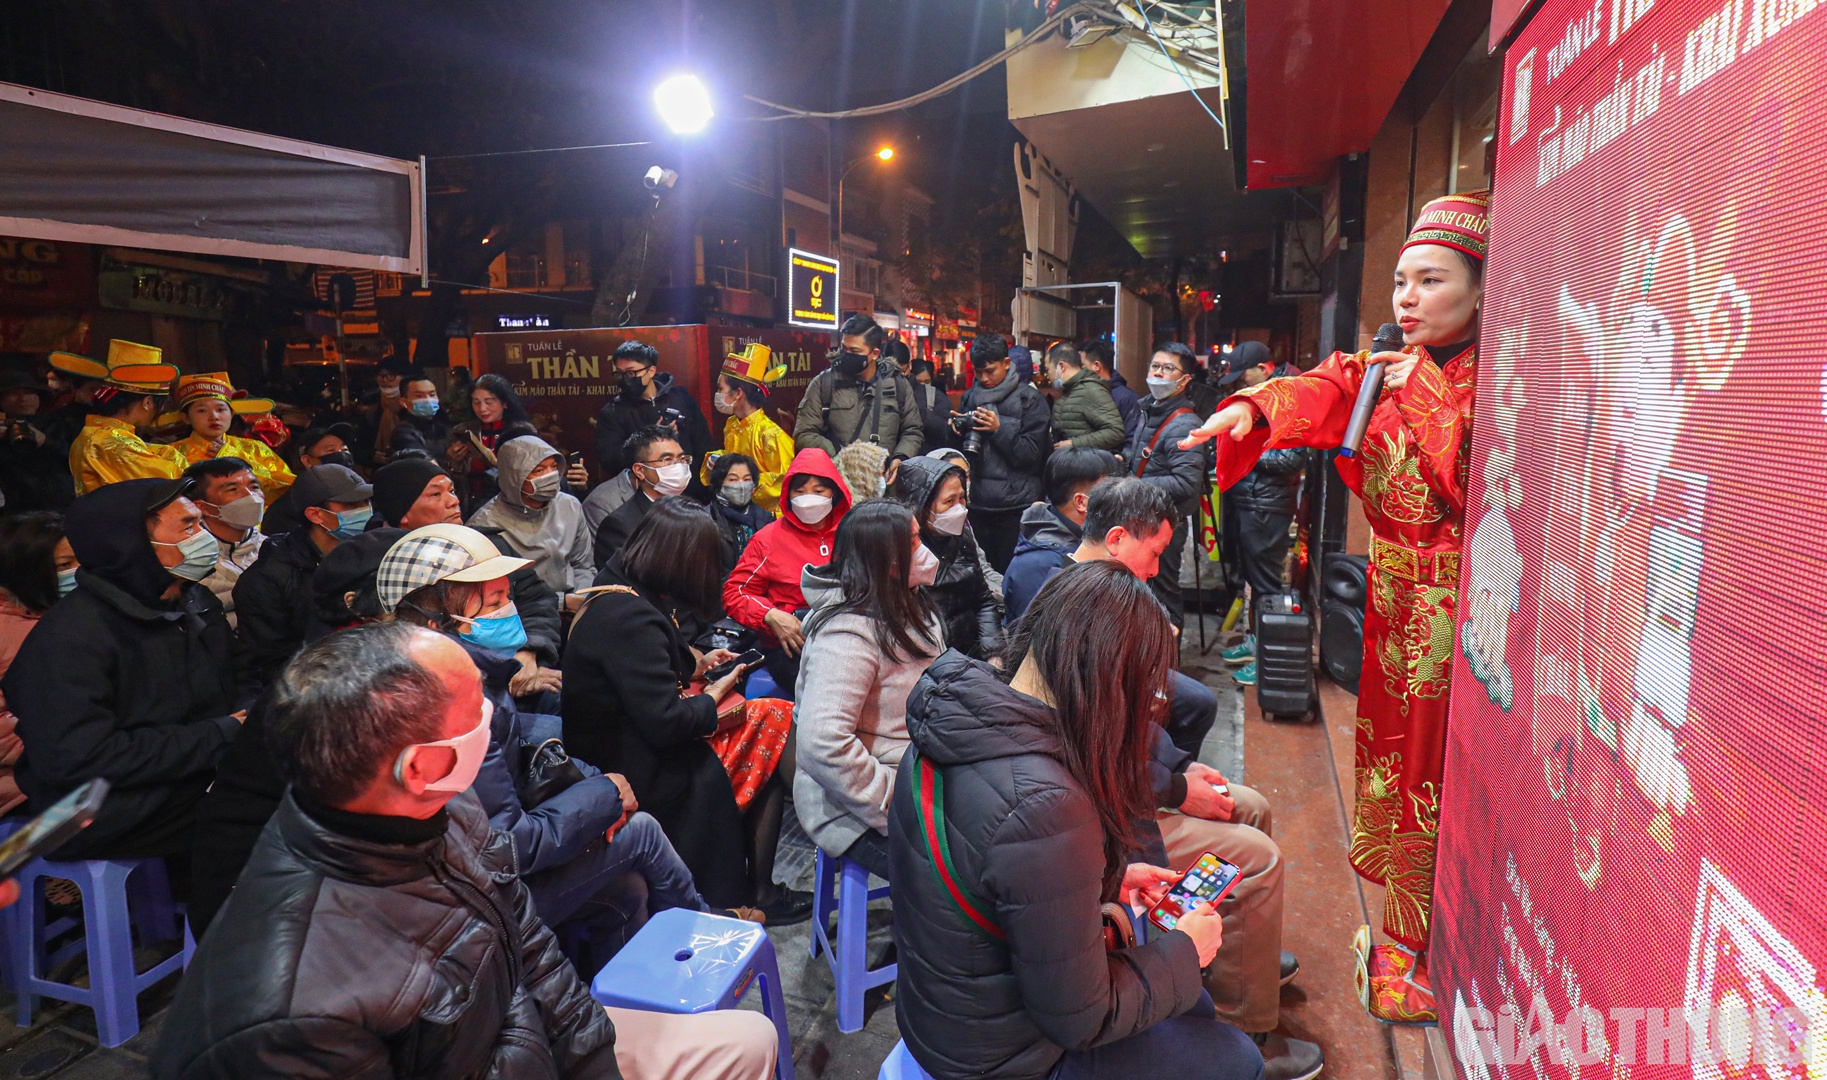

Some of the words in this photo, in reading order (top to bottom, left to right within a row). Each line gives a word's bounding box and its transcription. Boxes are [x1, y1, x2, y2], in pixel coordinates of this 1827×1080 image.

[1428, 210, 1458, 225] MINH
[1455, 212, 1487, 234] CHÂU
[527, 349, 600, 379] THẦN
[788, 348, 811, 371] TÀI
